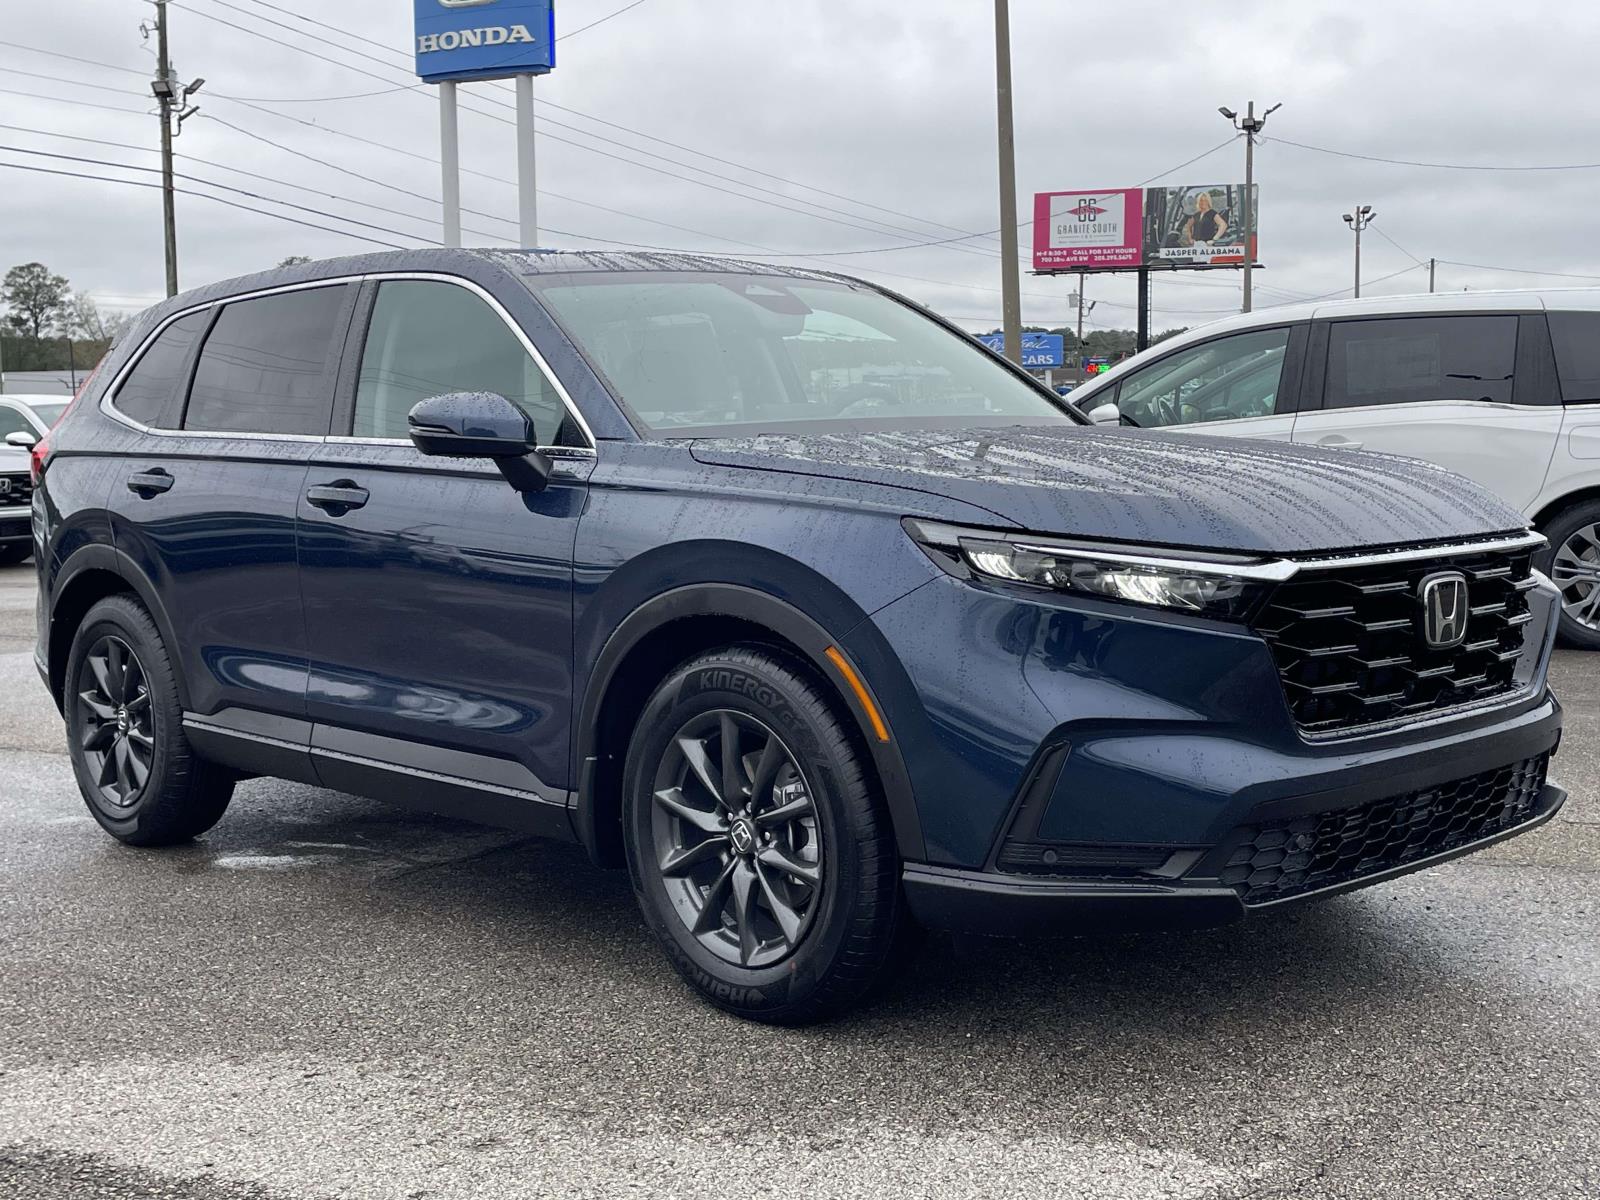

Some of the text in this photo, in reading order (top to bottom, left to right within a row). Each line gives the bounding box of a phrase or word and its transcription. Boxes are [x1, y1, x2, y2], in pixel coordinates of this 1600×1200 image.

[417, 25, 535, 53] HONDA
[1057, 223, 1117, 234] GRANITE SOUTH
[1165, 247, 1241, 256] JASPER ALABAMA
[700, 670, 785, 708] KINERGY
